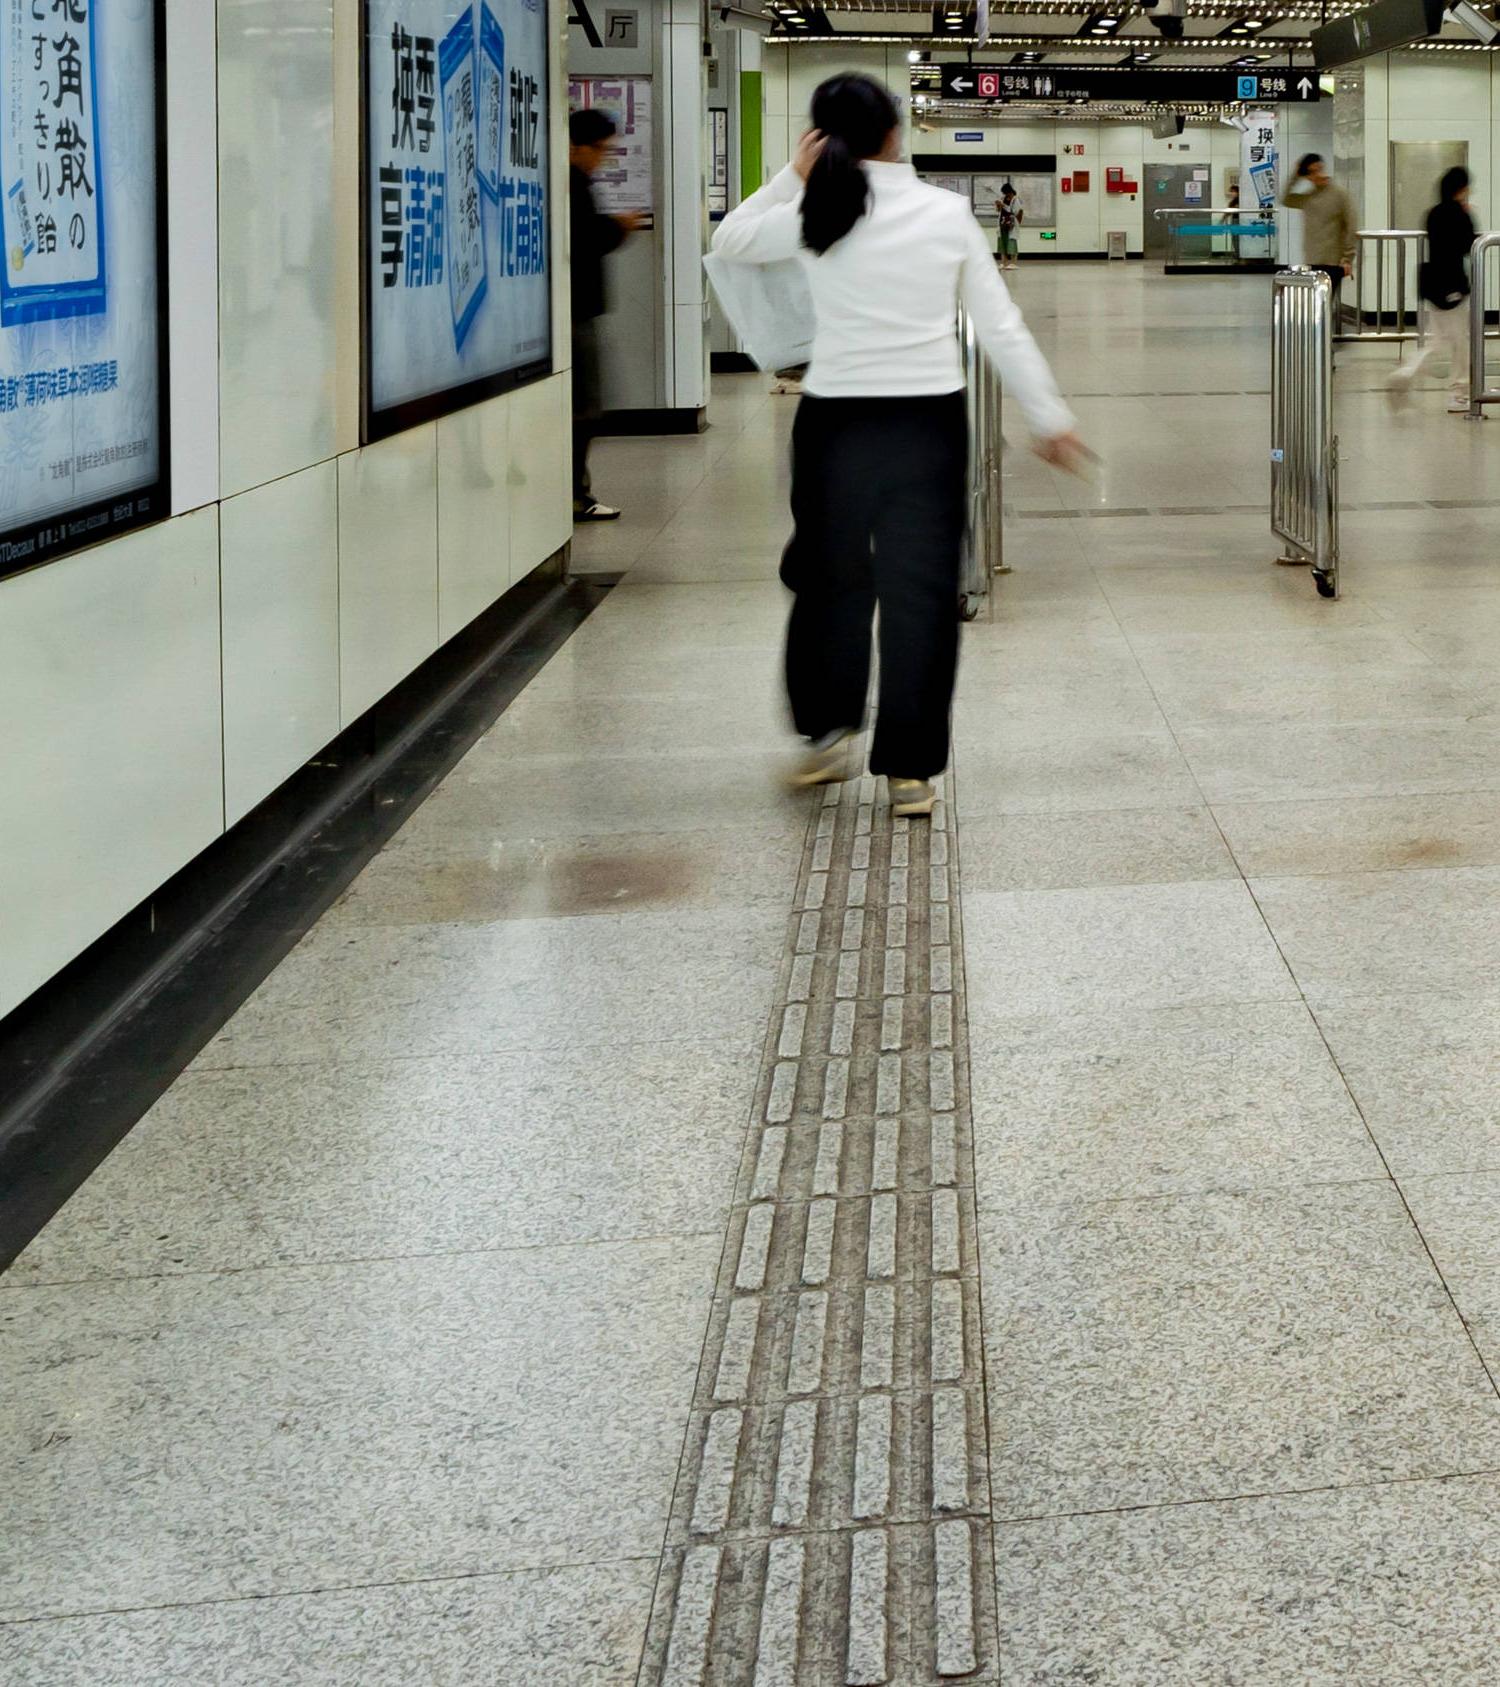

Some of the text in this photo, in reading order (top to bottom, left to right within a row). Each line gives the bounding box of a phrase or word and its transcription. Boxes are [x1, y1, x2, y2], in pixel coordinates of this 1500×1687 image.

[609, 15, 633, 39] 厅
[982, 76, 1029, 94] 6 号线
[1242, 78, 1286, 96] 9 号线
